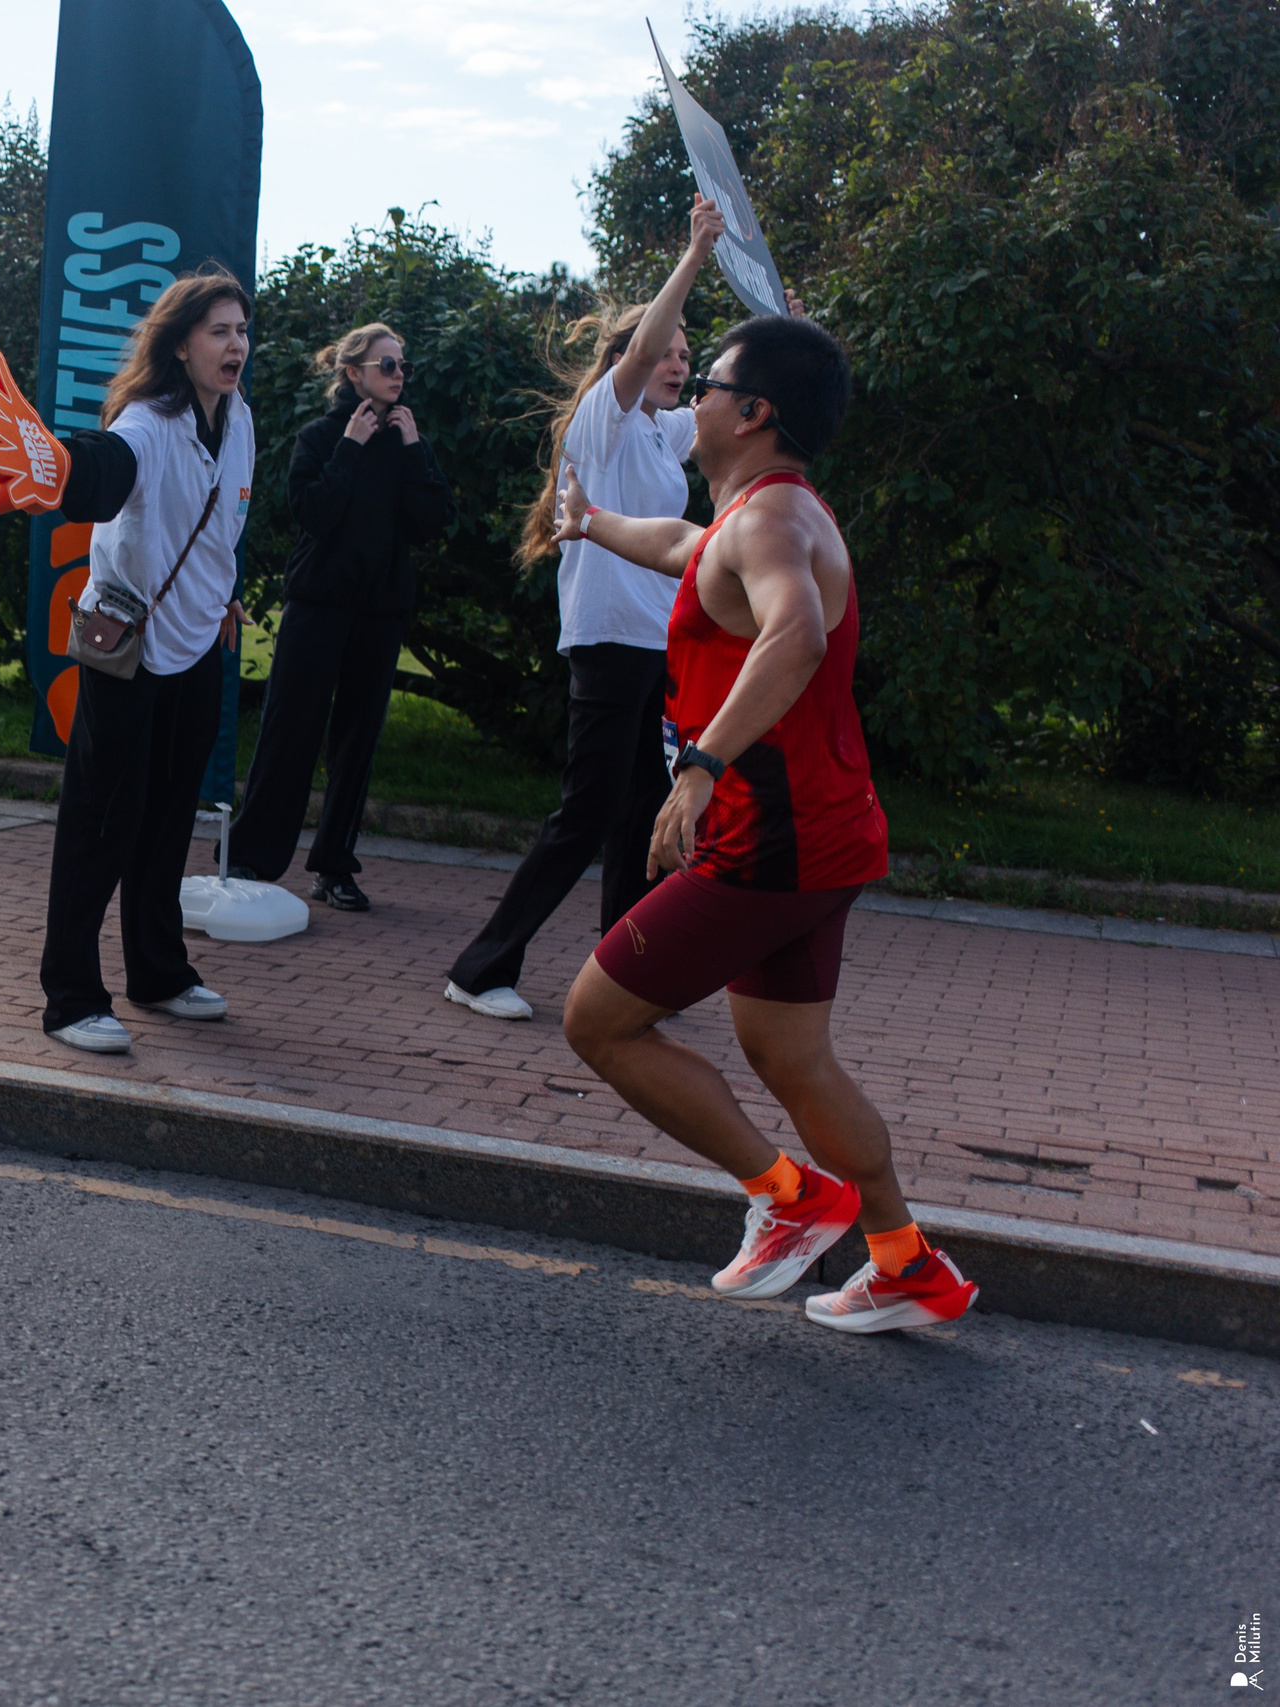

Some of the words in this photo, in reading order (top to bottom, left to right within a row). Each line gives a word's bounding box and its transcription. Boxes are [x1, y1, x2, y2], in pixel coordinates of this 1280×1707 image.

[53, 211, 181, 438] TNESS
[14, 414, 45, 485] DDX
[25, 419, 58, 488] FITNESS
